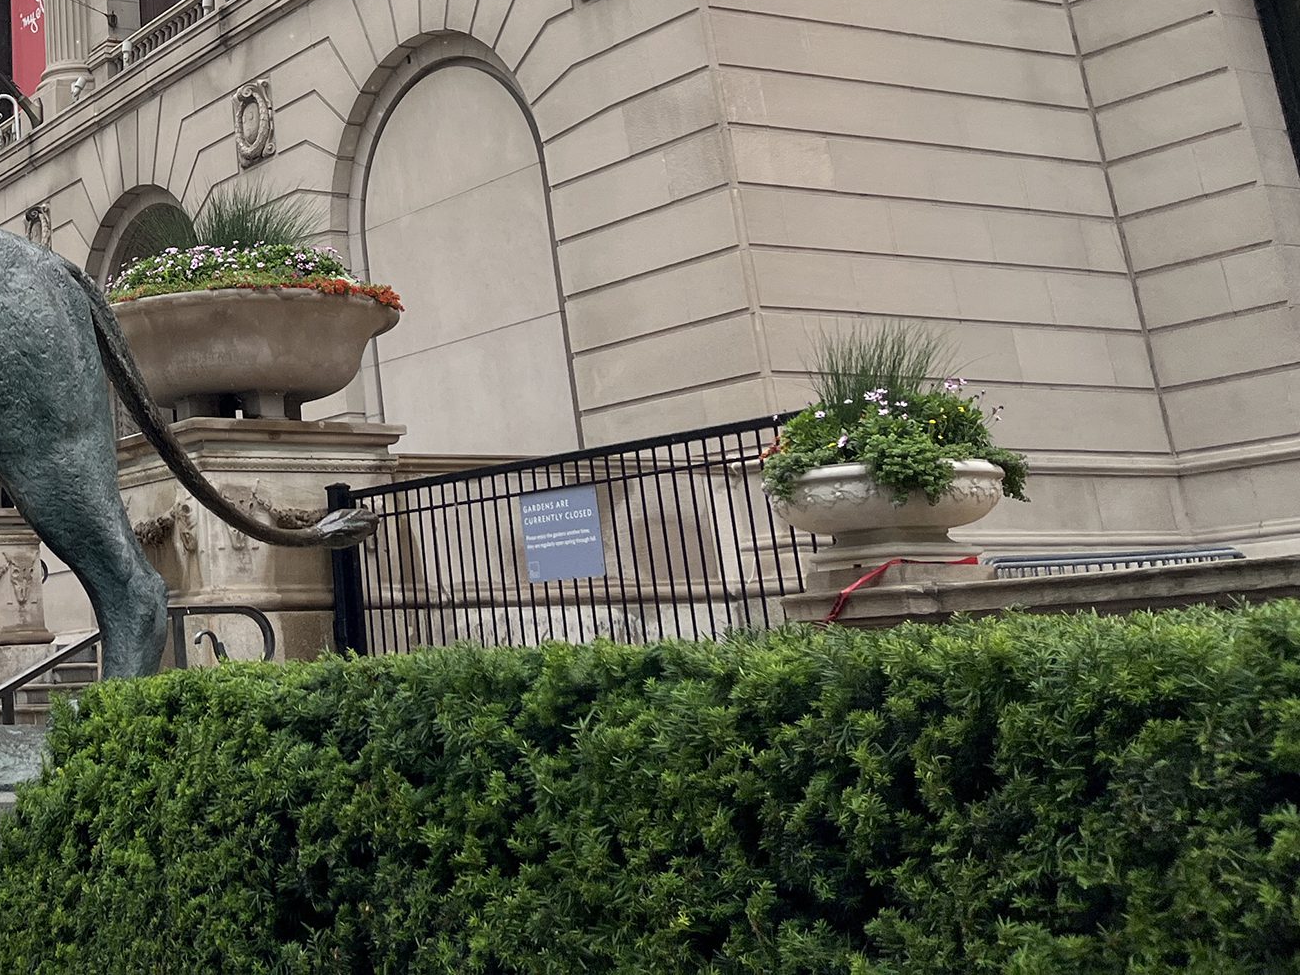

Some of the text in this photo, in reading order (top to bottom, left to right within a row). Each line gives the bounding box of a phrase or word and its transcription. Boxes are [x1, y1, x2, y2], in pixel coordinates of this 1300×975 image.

[522, 499, 569, 514] GARDENS ARE
[524, 508, 593, 526] CURRENTLY CLOSED
